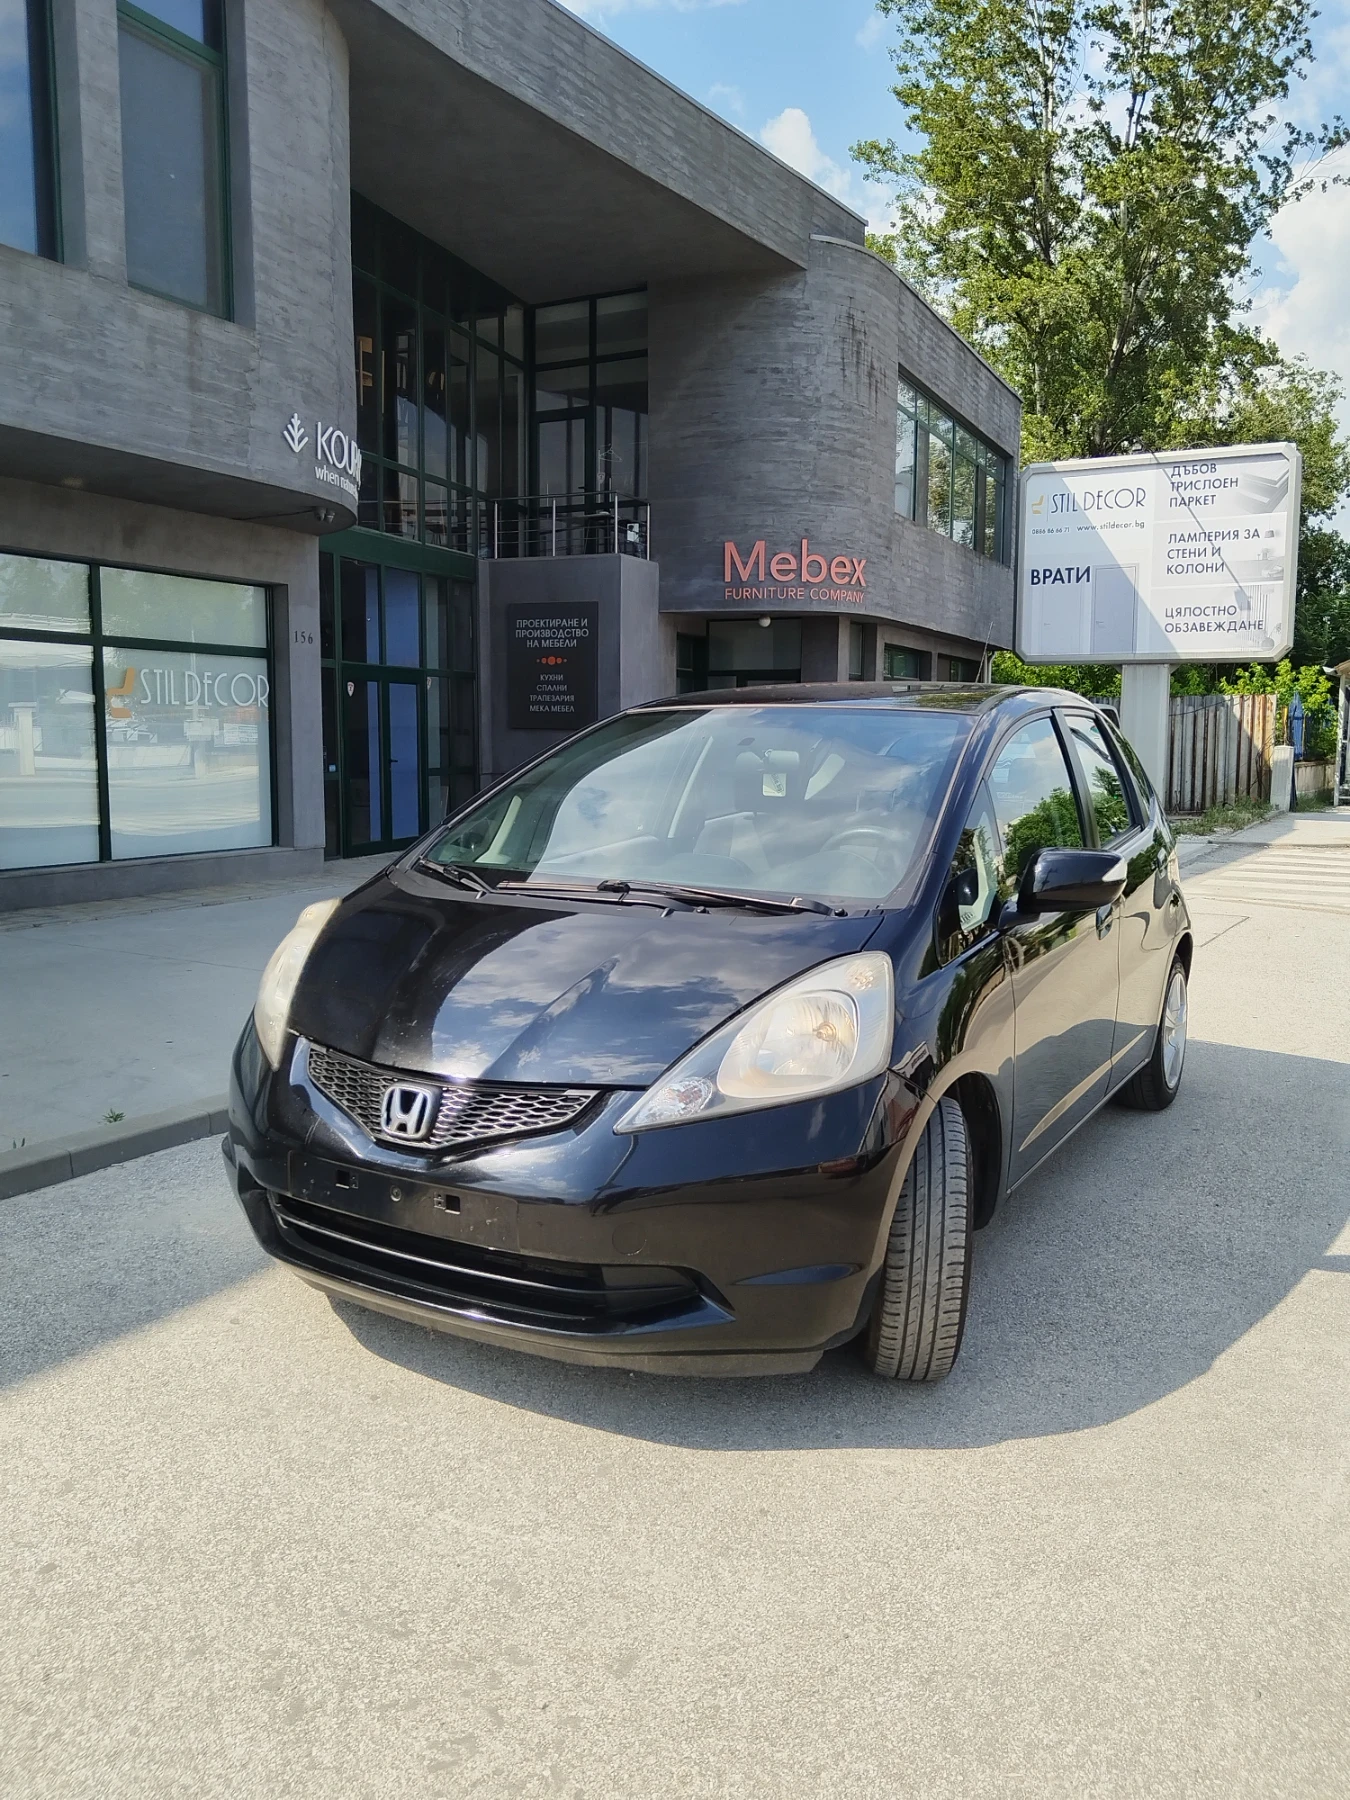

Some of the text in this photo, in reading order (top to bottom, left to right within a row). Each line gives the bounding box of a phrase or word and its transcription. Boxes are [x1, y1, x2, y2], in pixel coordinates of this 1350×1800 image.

[315, 465, 339, 487] when
[1170, 463, 1217, 479] ДЪБОВ
[1170, 477, 1239, 492] ТРИСЛОЕН
[1051, 487, 1146, 514] STIL DECOR
[1169, 494, 1217, 508] ПАРКЕТ
[1076, 520, 1145, 532] www.stildecor.bg
[1168, 528, 1261, 544] ЛАМПЕРИЯ ЗА
[1167, 547, 1221, 560] СТЕНИ И
[724, 538, 867, 587] Mebex
[1166, 562, 1225, 575] КОЛОНИ
[1030, 566, 1091, 586] ВРАТИ
[724, 587, 865, 604] FURNITURE COMPANY
[1165, 605, 1237, 619] ЦЯЛОСТНО
[516, 618, 588, 628] ПРОЕКТИРАНЕ И
[1164, 619, 1264, 633] ОБЗАВЕЖДАНЕ
[294, 630, 314, 645] 156
[515, 628, 589, 638] ПРОИЗВОДСТВО
[526, 639, 577, 648] НА МЕБЕЛИ
[536, 684, 567, 692] СПАЛНИ
[529, 694, 575, 702] ТРАПЕЗАРИЯ
[551, 705, 575, 713] МЕБЕЛ
